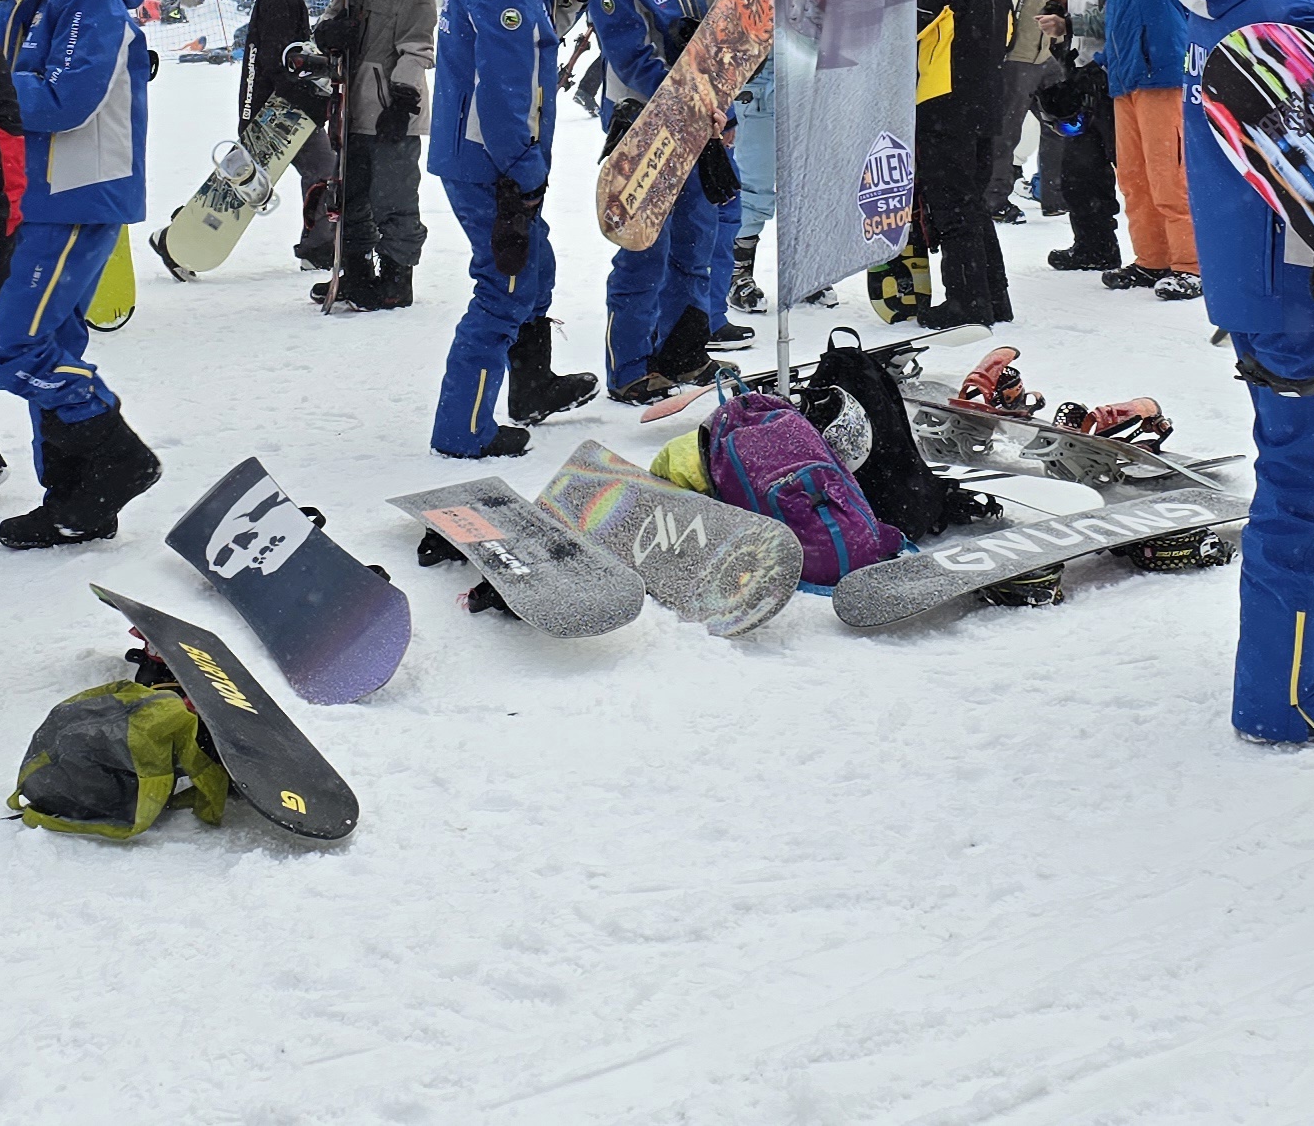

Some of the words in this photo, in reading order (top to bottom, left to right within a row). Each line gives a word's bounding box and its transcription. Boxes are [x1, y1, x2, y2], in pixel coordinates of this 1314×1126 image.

[877, 195, 906, 213] SKI
[932, 520, 1085, 571] GNU
[178, 641, 260, 715] BURTON
